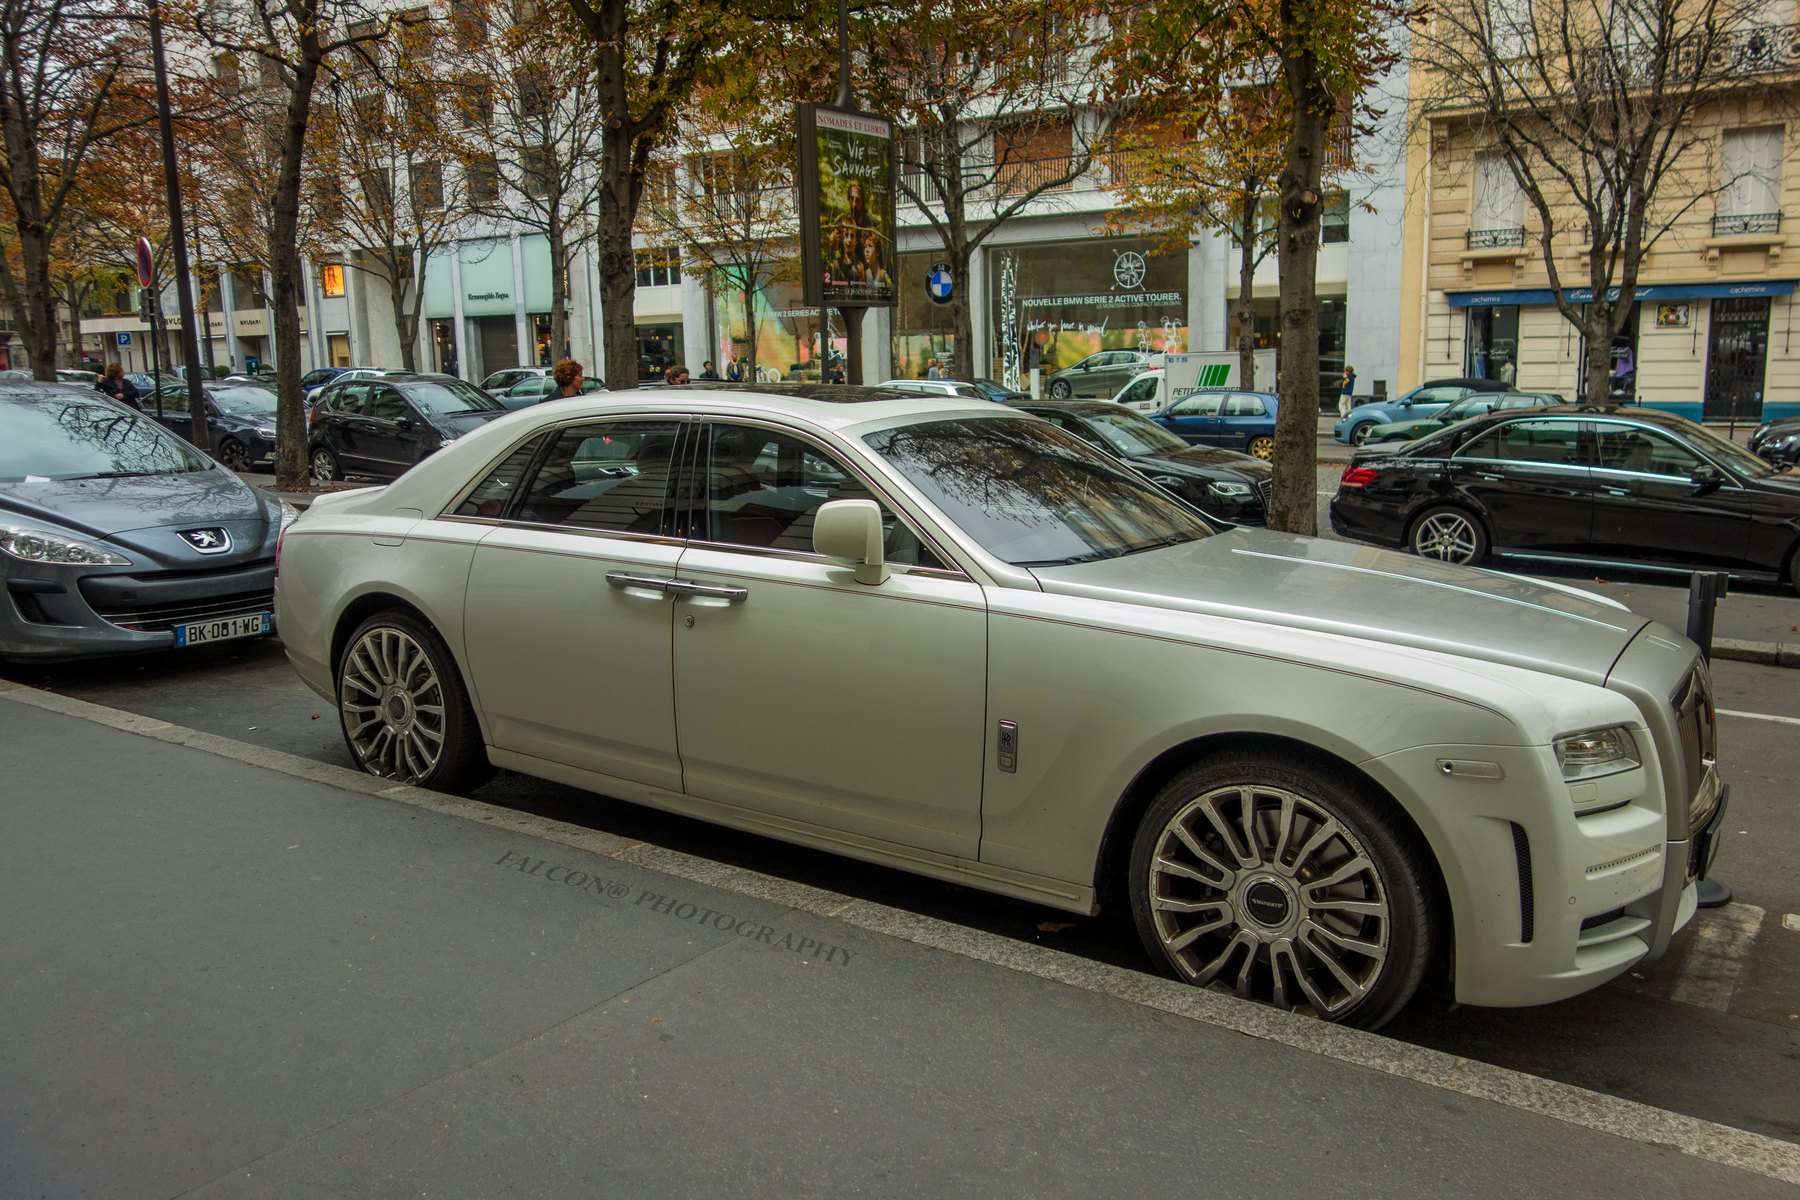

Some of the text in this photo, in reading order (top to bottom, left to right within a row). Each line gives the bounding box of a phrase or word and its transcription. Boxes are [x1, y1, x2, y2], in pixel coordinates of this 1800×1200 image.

[833, 155, 880, 179] SAUVAGE
[1022, 299, 1063, 307] NOUVELLE
[1084, 296, 1107, 304] SERIE
[1108, 296, 1114, 304] 2
[1115, 294, 1144, 303] ACTIVE
